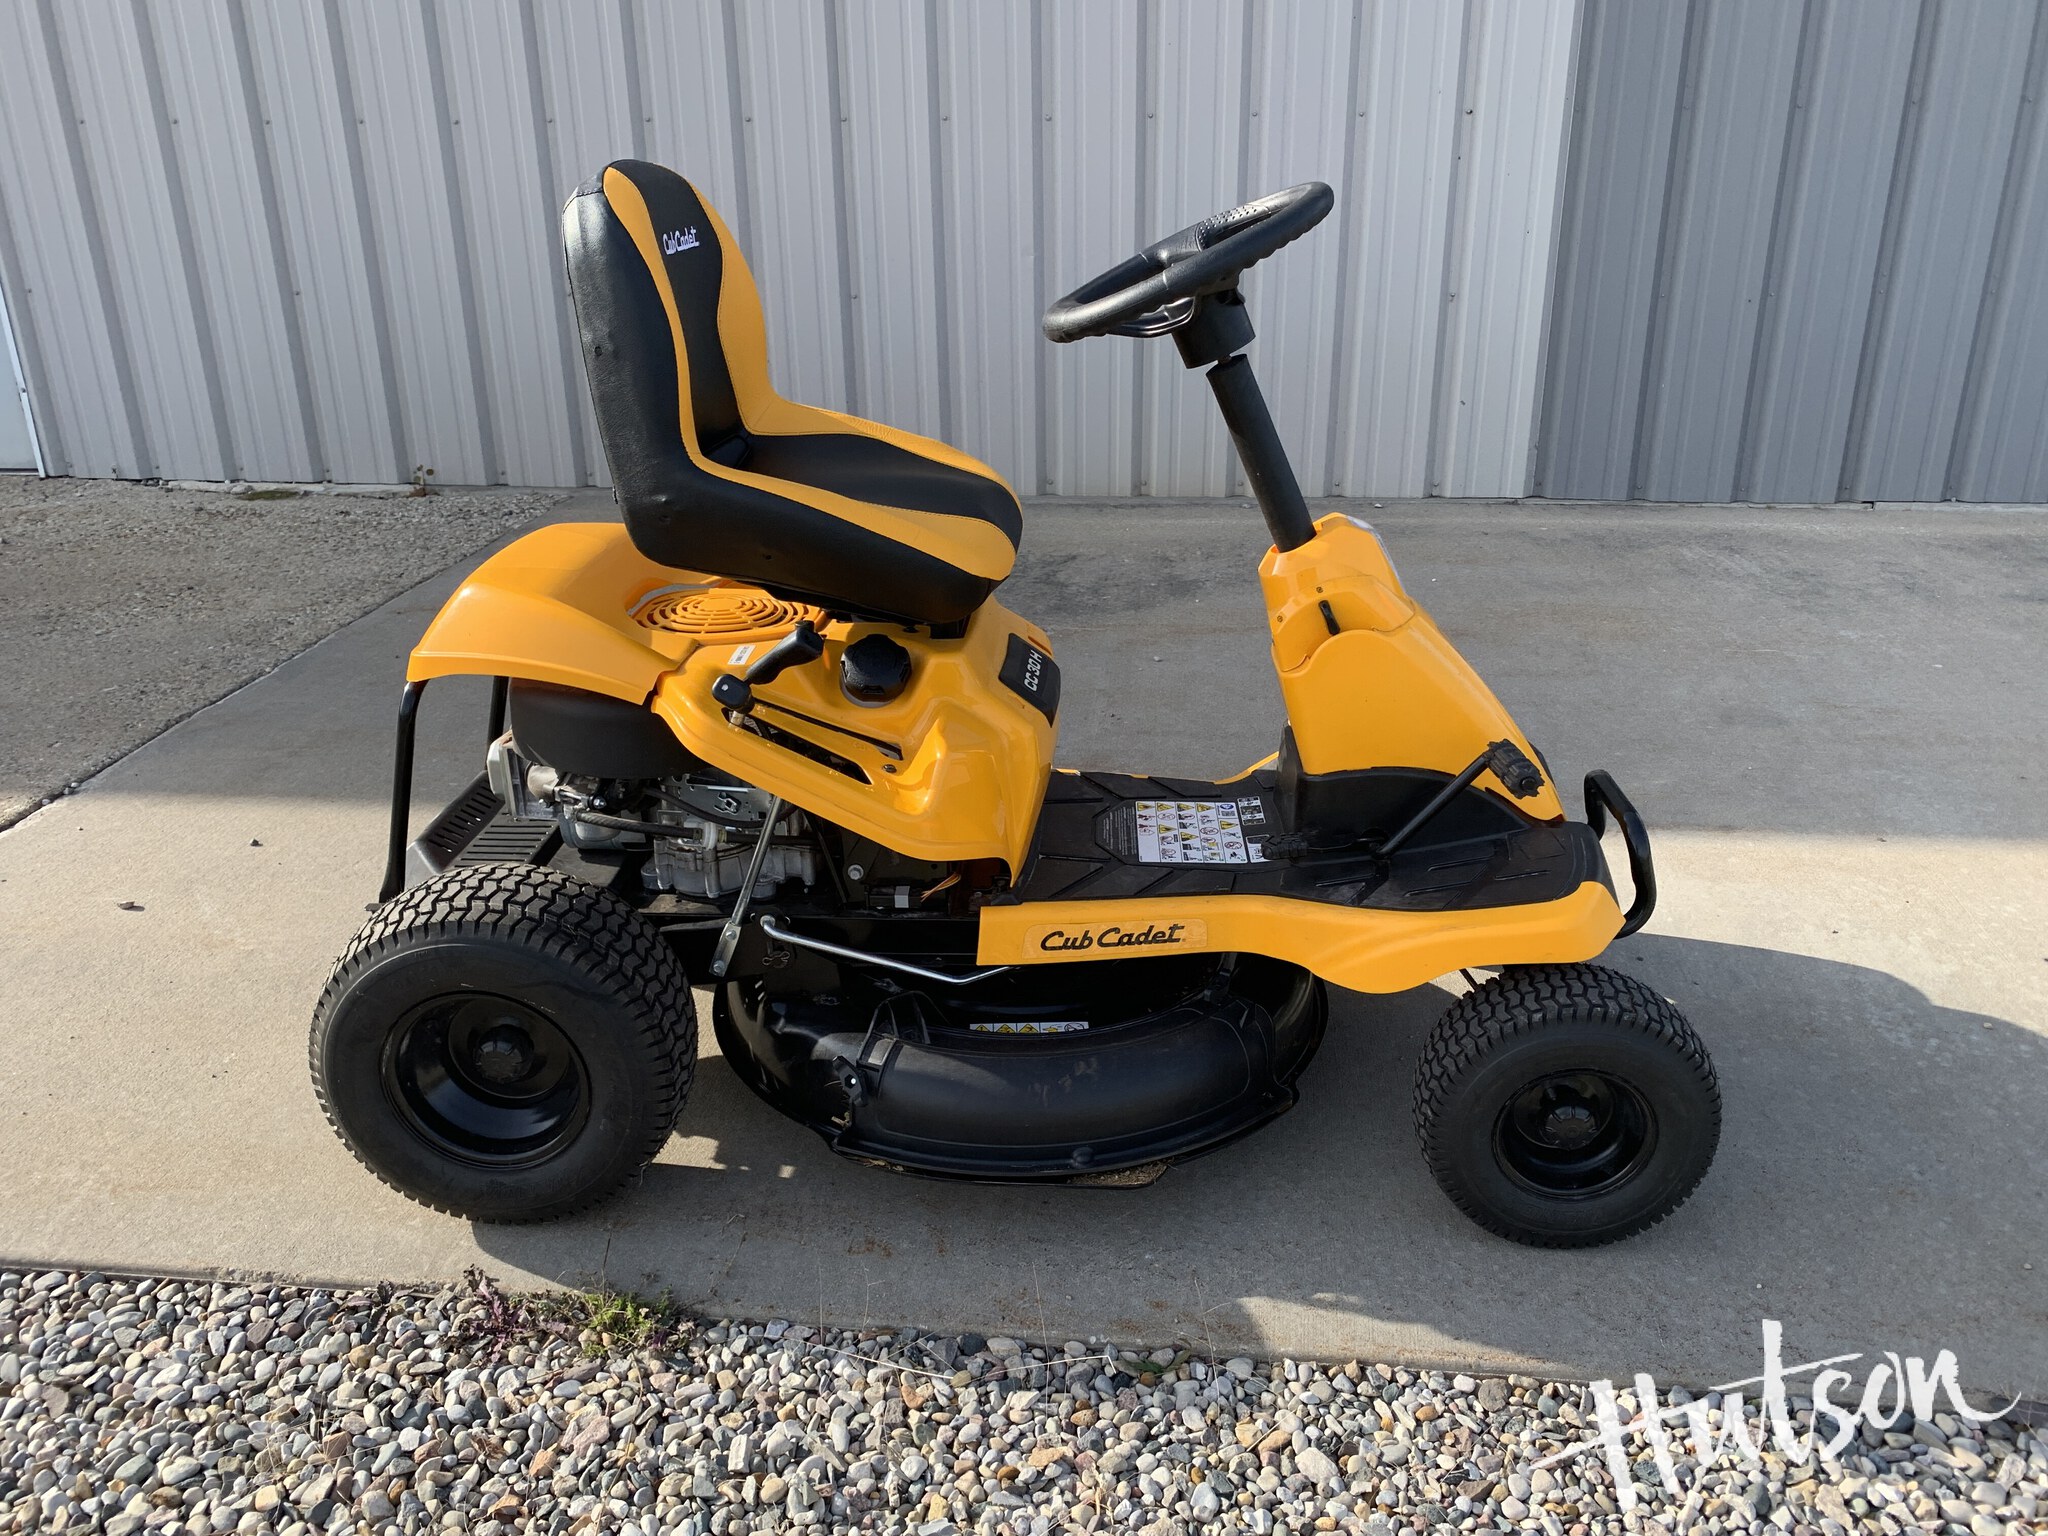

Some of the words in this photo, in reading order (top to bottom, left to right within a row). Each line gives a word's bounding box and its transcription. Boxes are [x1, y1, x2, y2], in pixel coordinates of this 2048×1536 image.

[675, 225, 700, 252] Cadet
[1029, 649, 1043, 663] H
[1027, 658, 1041, 676] 30
[1024, 672, 1039, 692] CC
[1040, 930, 1094, 952] Cub
[1097, 923, 1186, 948] Cadet
